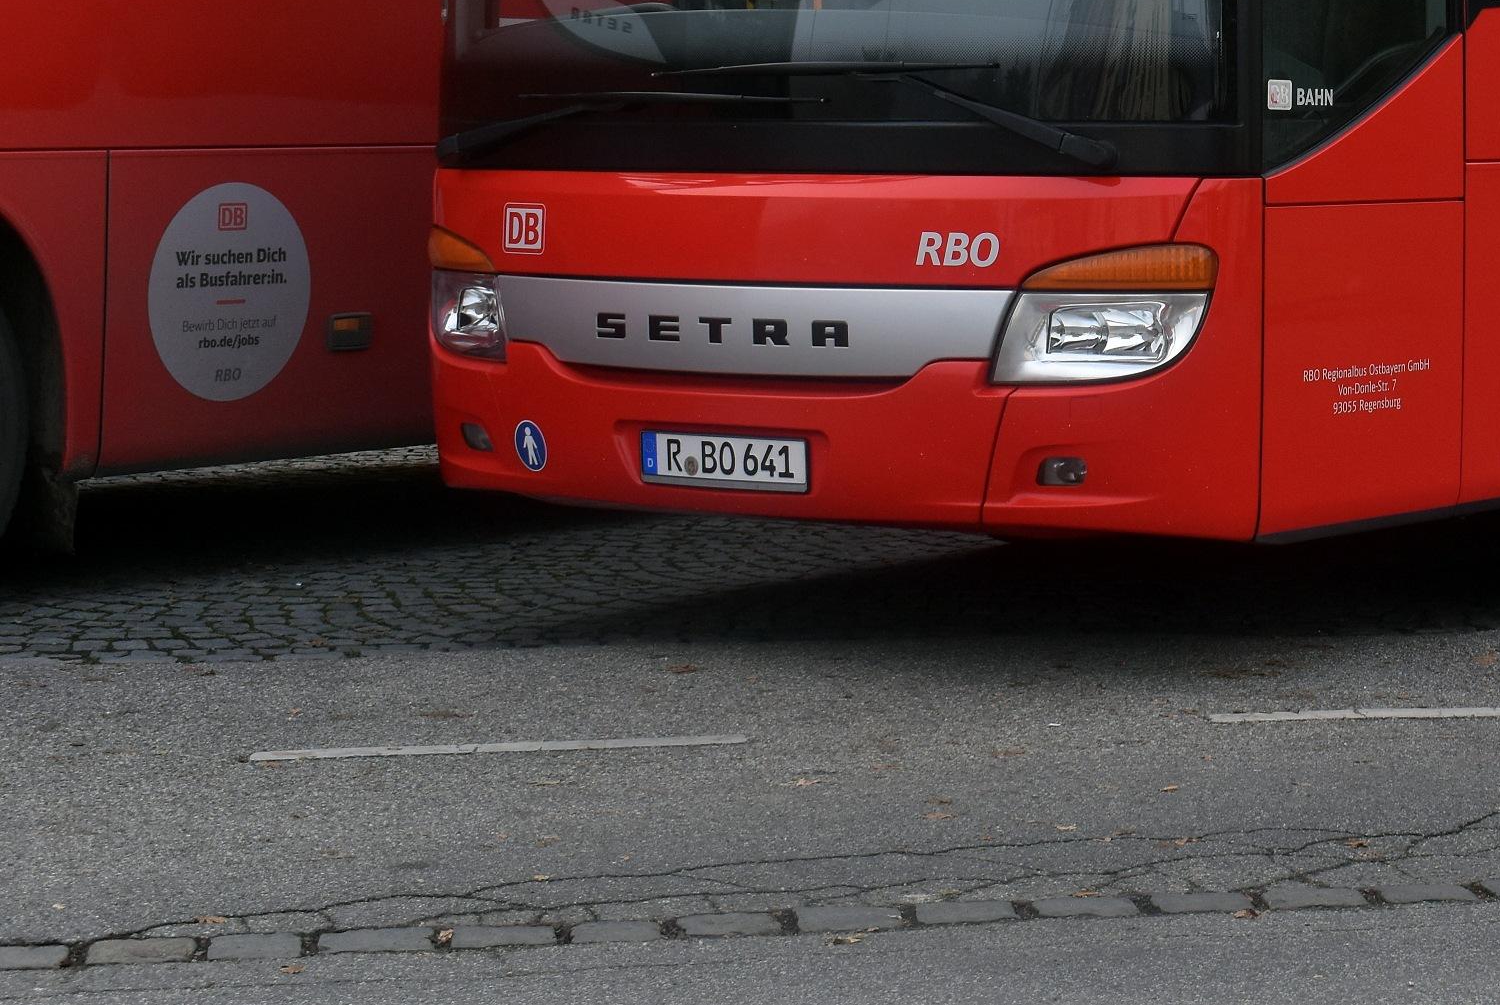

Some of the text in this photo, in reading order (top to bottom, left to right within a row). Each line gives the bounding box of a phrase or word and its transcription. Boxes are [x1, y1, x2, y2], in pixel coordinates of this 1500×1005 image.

[1297, 88, 1333, 106] BAHN
[220, 206, 245, 228] DB
[508, 210, 540, 247] DB
[176, 247, 287, 266] Wir suchen Dich
[916, 231, 1000, 268] RBO
[176, 270, 287, 289] als Busfahrer:in.
[182, 315, 276, 333] Bewirb Dich jetzt auf
[597, 313, 849, 348] SETRA
[198, 334, 260, 349] rbo.de/jobs
[214, 368, 242, 382] RBO
[1303, 359, 1430, 383] RBO Regionalbus Ostbayern GmbH
[1338, 379, 1397, 396] Von-Donle-Str. 7
[1333, 397, 1401, 414] 93055 Regensburg
[647, 458, 653, 468] D
[667, 438, 794, 478] R BO 641
